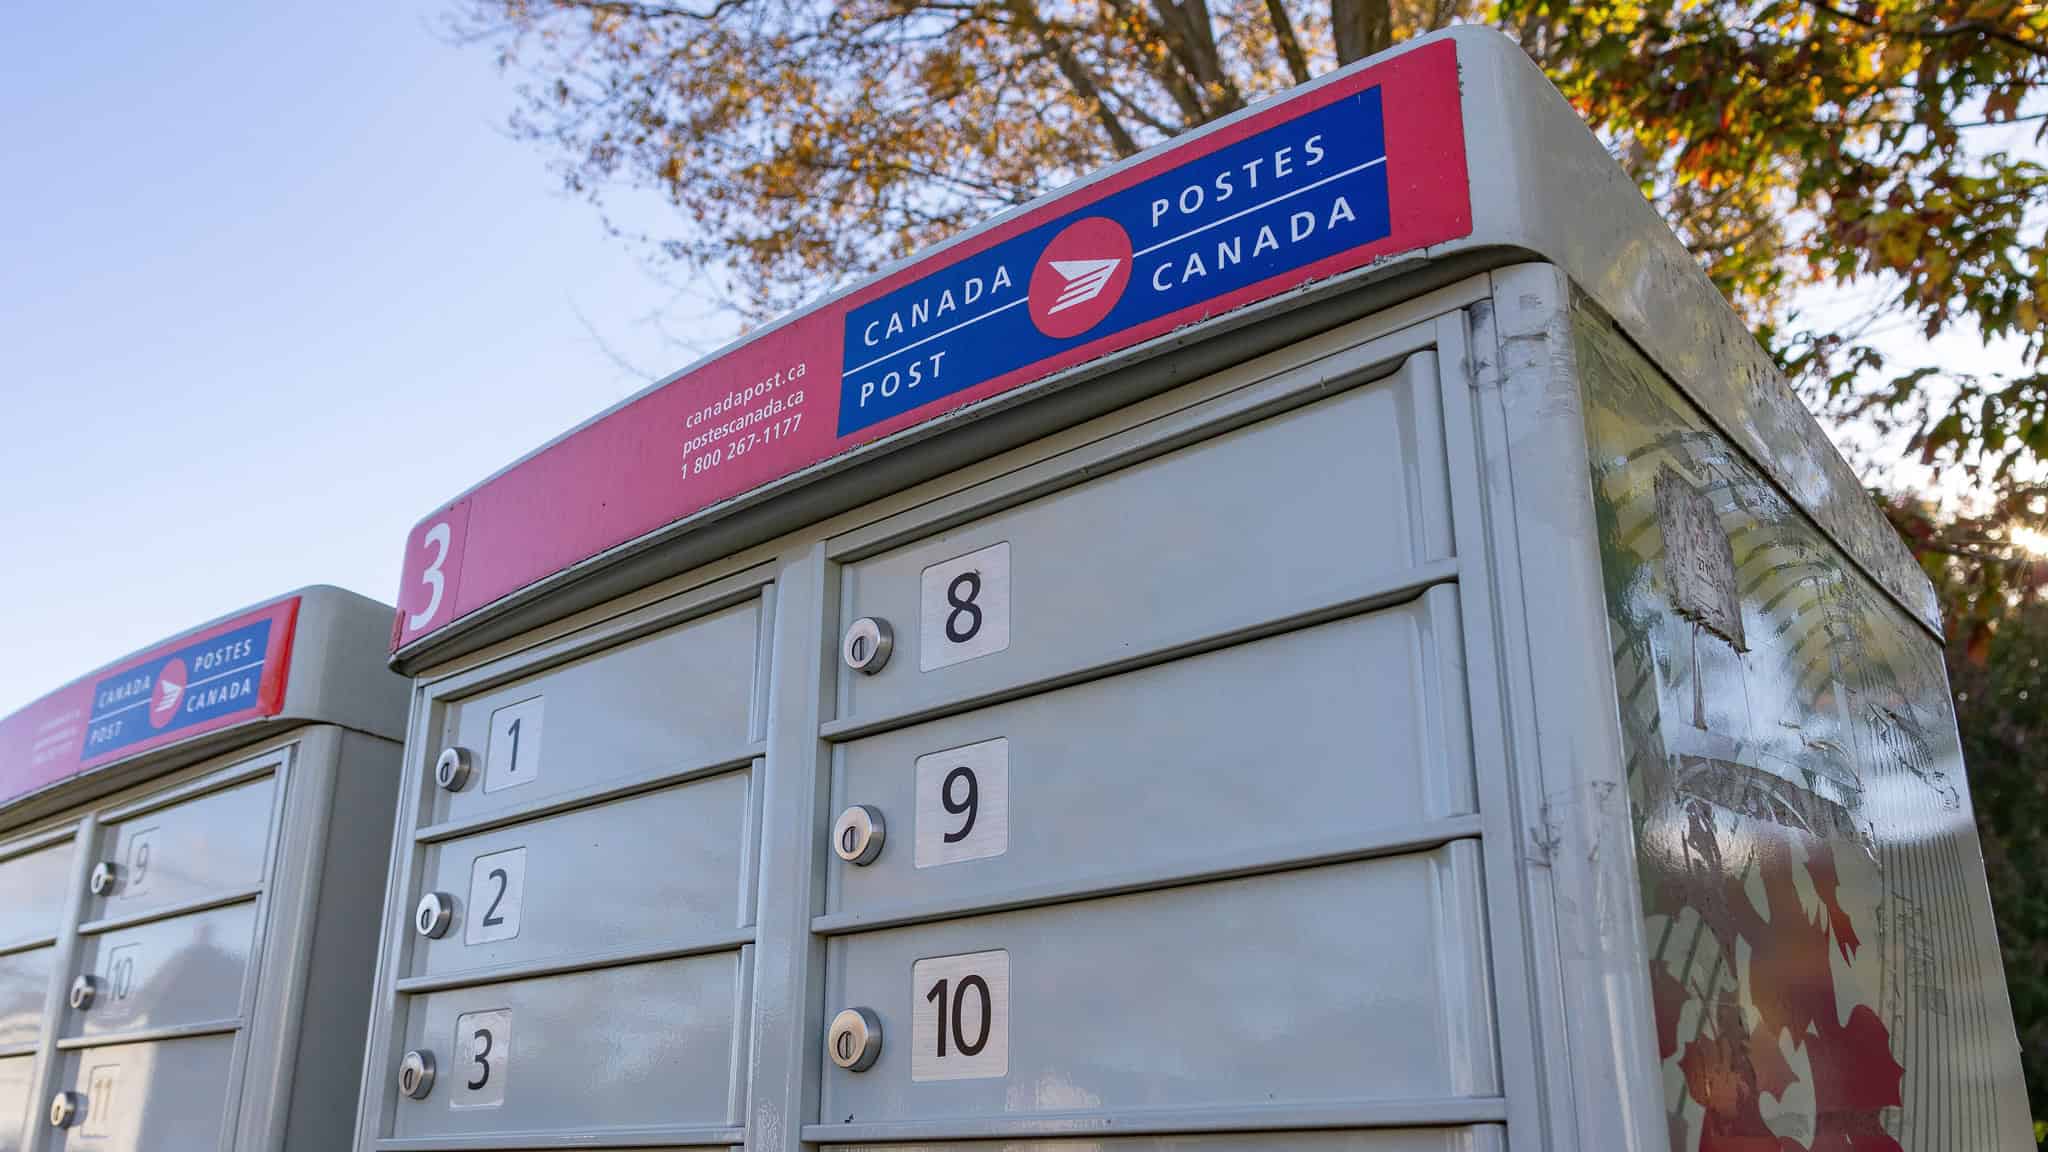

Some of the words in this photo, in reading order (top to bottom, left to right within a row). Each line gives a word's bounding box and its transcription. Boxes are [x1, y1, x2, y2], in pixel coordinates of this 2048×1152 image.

[1152, 135, 1325, 228] POSTES
[1152, 196, 1356, 292] CANADA
[864, 265, 1012, 347] CANADA
[686, 362, 806, 429] canadapost.ca
[860, 351, 946, 408] POST
[681, 463, 688, 480] 1
[694, 449, 721, 475] 800
[727, 413, 802, 461] 267-1177
[682, 390, 804, 459] postescanada.ca
[409, 522, 450, 632] 3
[945, 571, 983, 644] 8
[193, 638, 252, 673] POSTES
[98, 675, 151, 708] CANADA
[186, 677, 251, 713] CANADA
[90, 719, 123, 746] POST
[507, 718, 521, 772] 1
[942, 766, 978, 844] 9
[132, 842, 150, 886] 9
[482, 869, 508, 928] 2
[110, 957, 134, 1001] 10
[926, 974, 991, 1058] 10
[467, 1028, 493, 1091] 3
